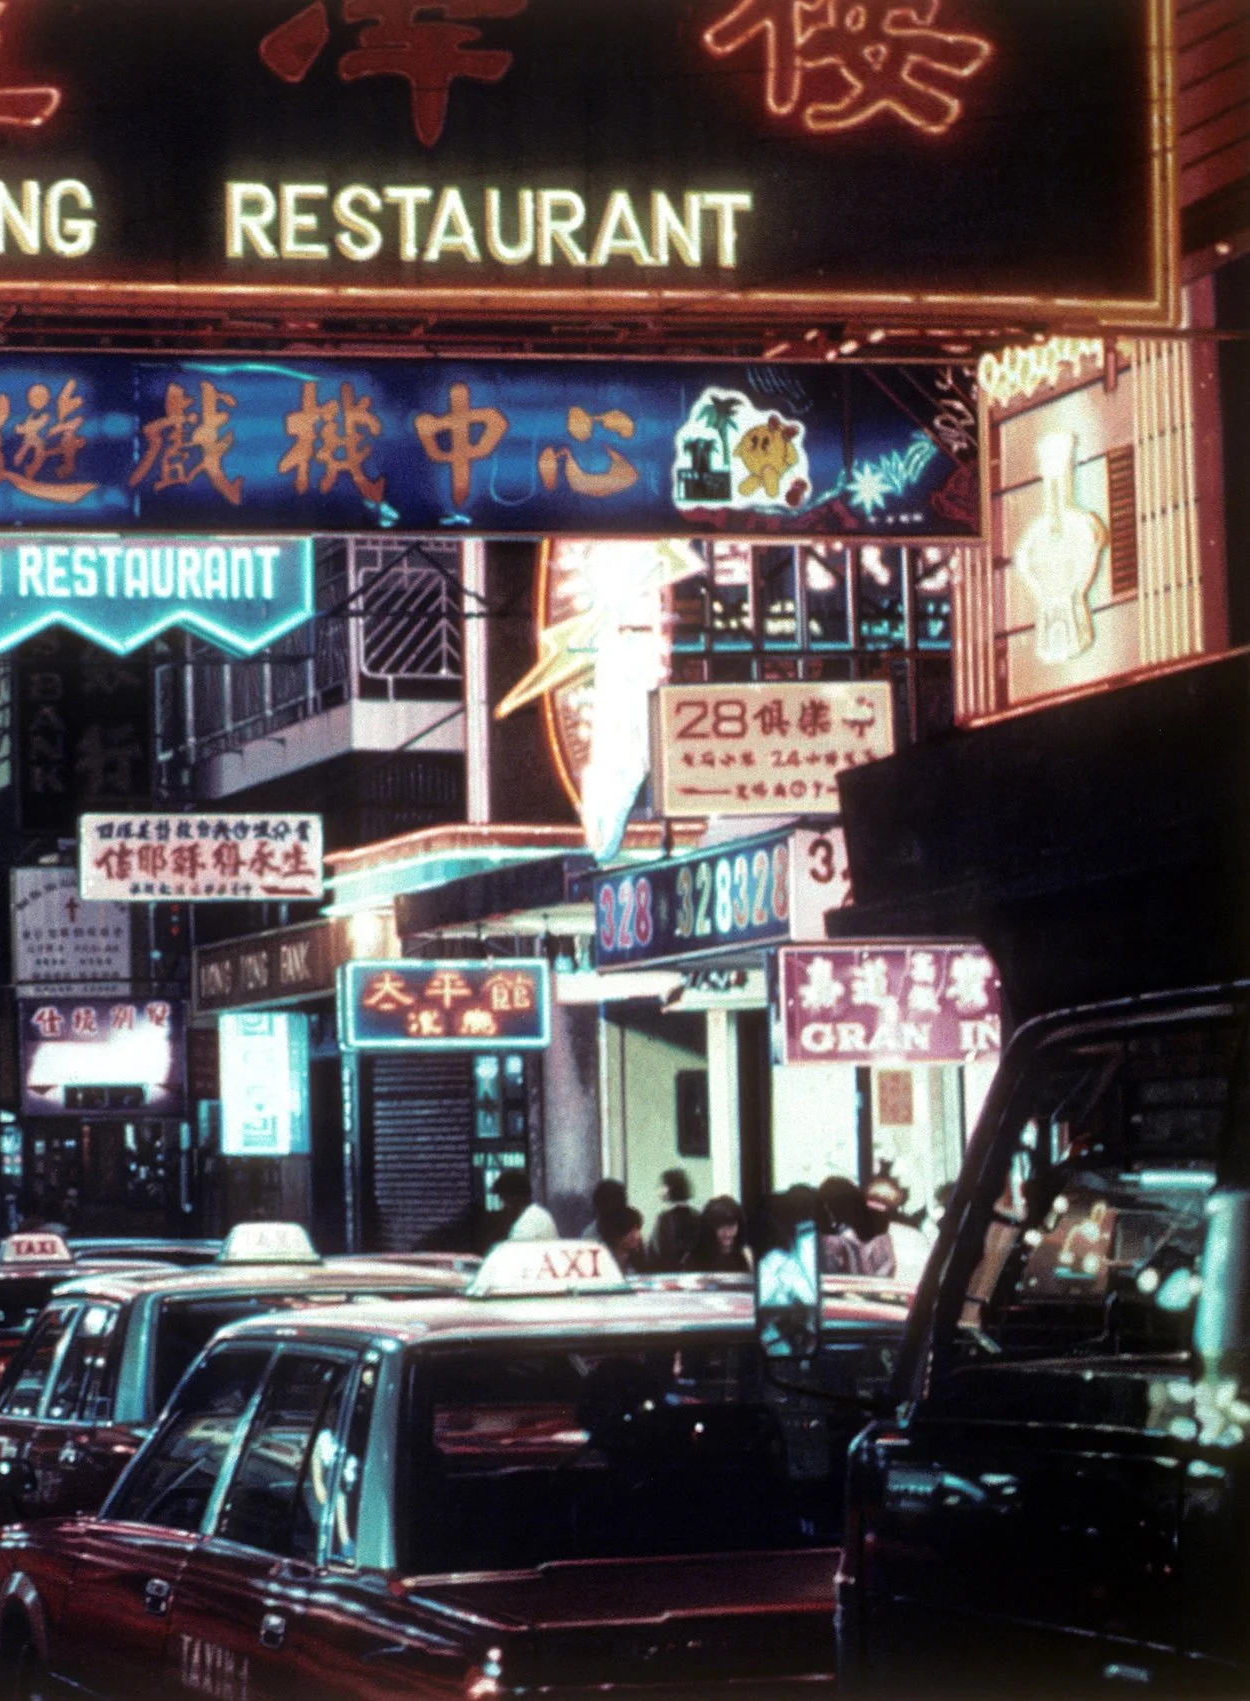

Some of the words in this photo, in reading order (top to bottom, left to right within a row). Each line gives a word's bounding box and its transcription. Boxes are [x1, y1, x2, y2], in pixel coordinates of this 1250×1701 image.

[224, 180, 754, 269] RESTAURANT
[19, 547, 280, 602] RESTAURANT
[598, 875, 654, 951] 328
[12, 1240, 58, 1255] TAXI
[518, 1248, 602, 1279] AXI
